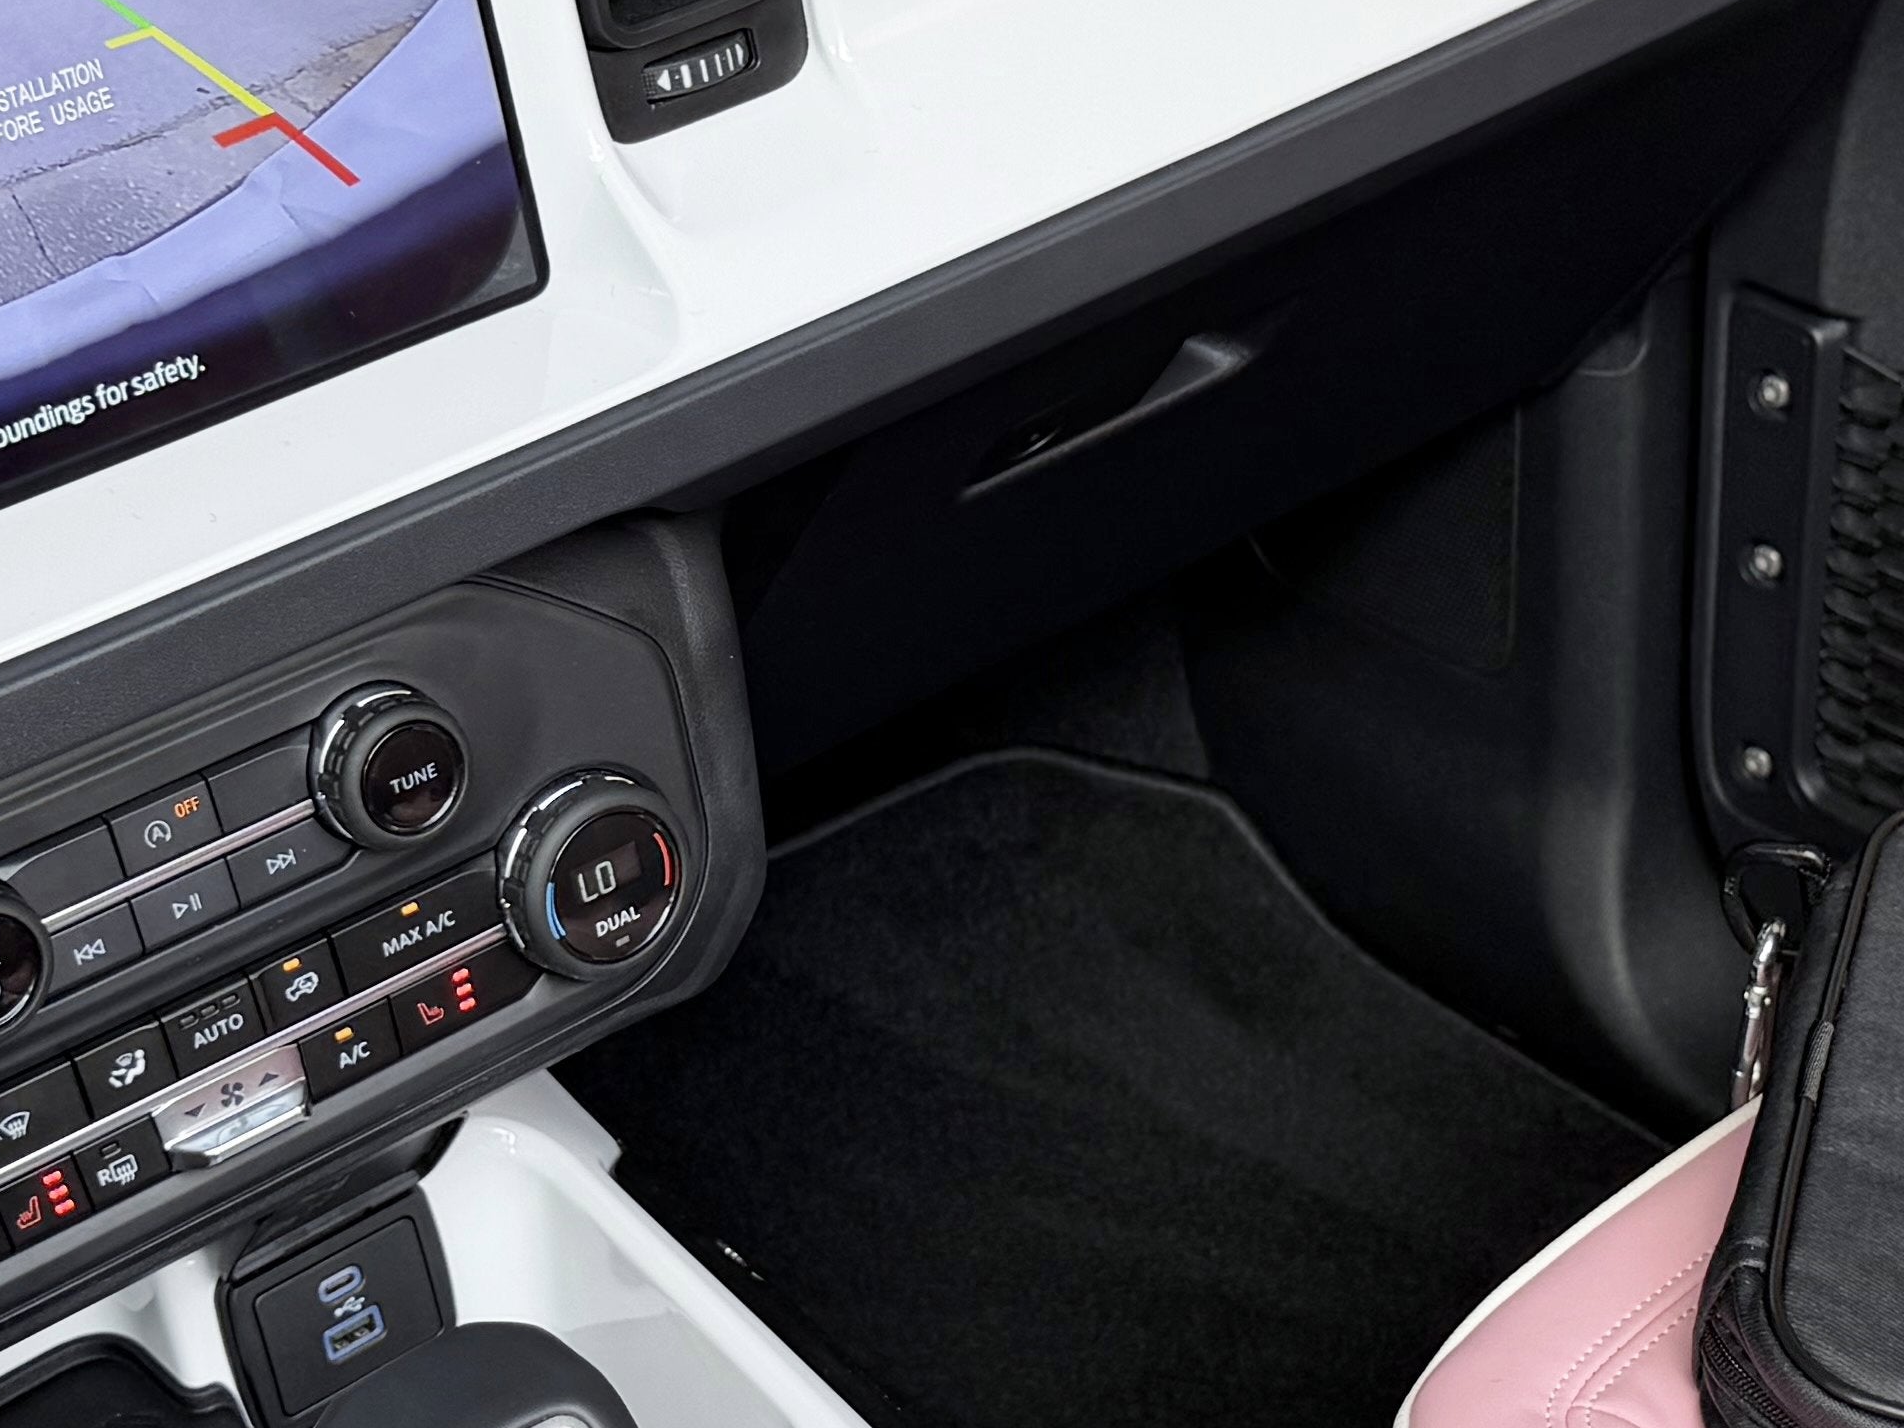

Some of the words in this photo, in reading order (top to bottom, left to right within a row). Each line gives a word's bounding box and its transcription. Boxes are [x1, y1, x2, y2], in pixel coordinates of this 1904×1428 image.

[52, 87, 115, 126] USAGE
[94, 379, 128, 411] for
[131, 354, 207, 397] safety.
[389, 762, 439, 796] TUNE
[174, 796, 200, 819] OFF
[382, 930, 424, 958] MAX
[425, 910, 457, 938] A/C
[594, 906, 642, 938] DUAL
[192, 1014, 245, 1050] AUTO
[338, 1041, 371, 1070] A/C
